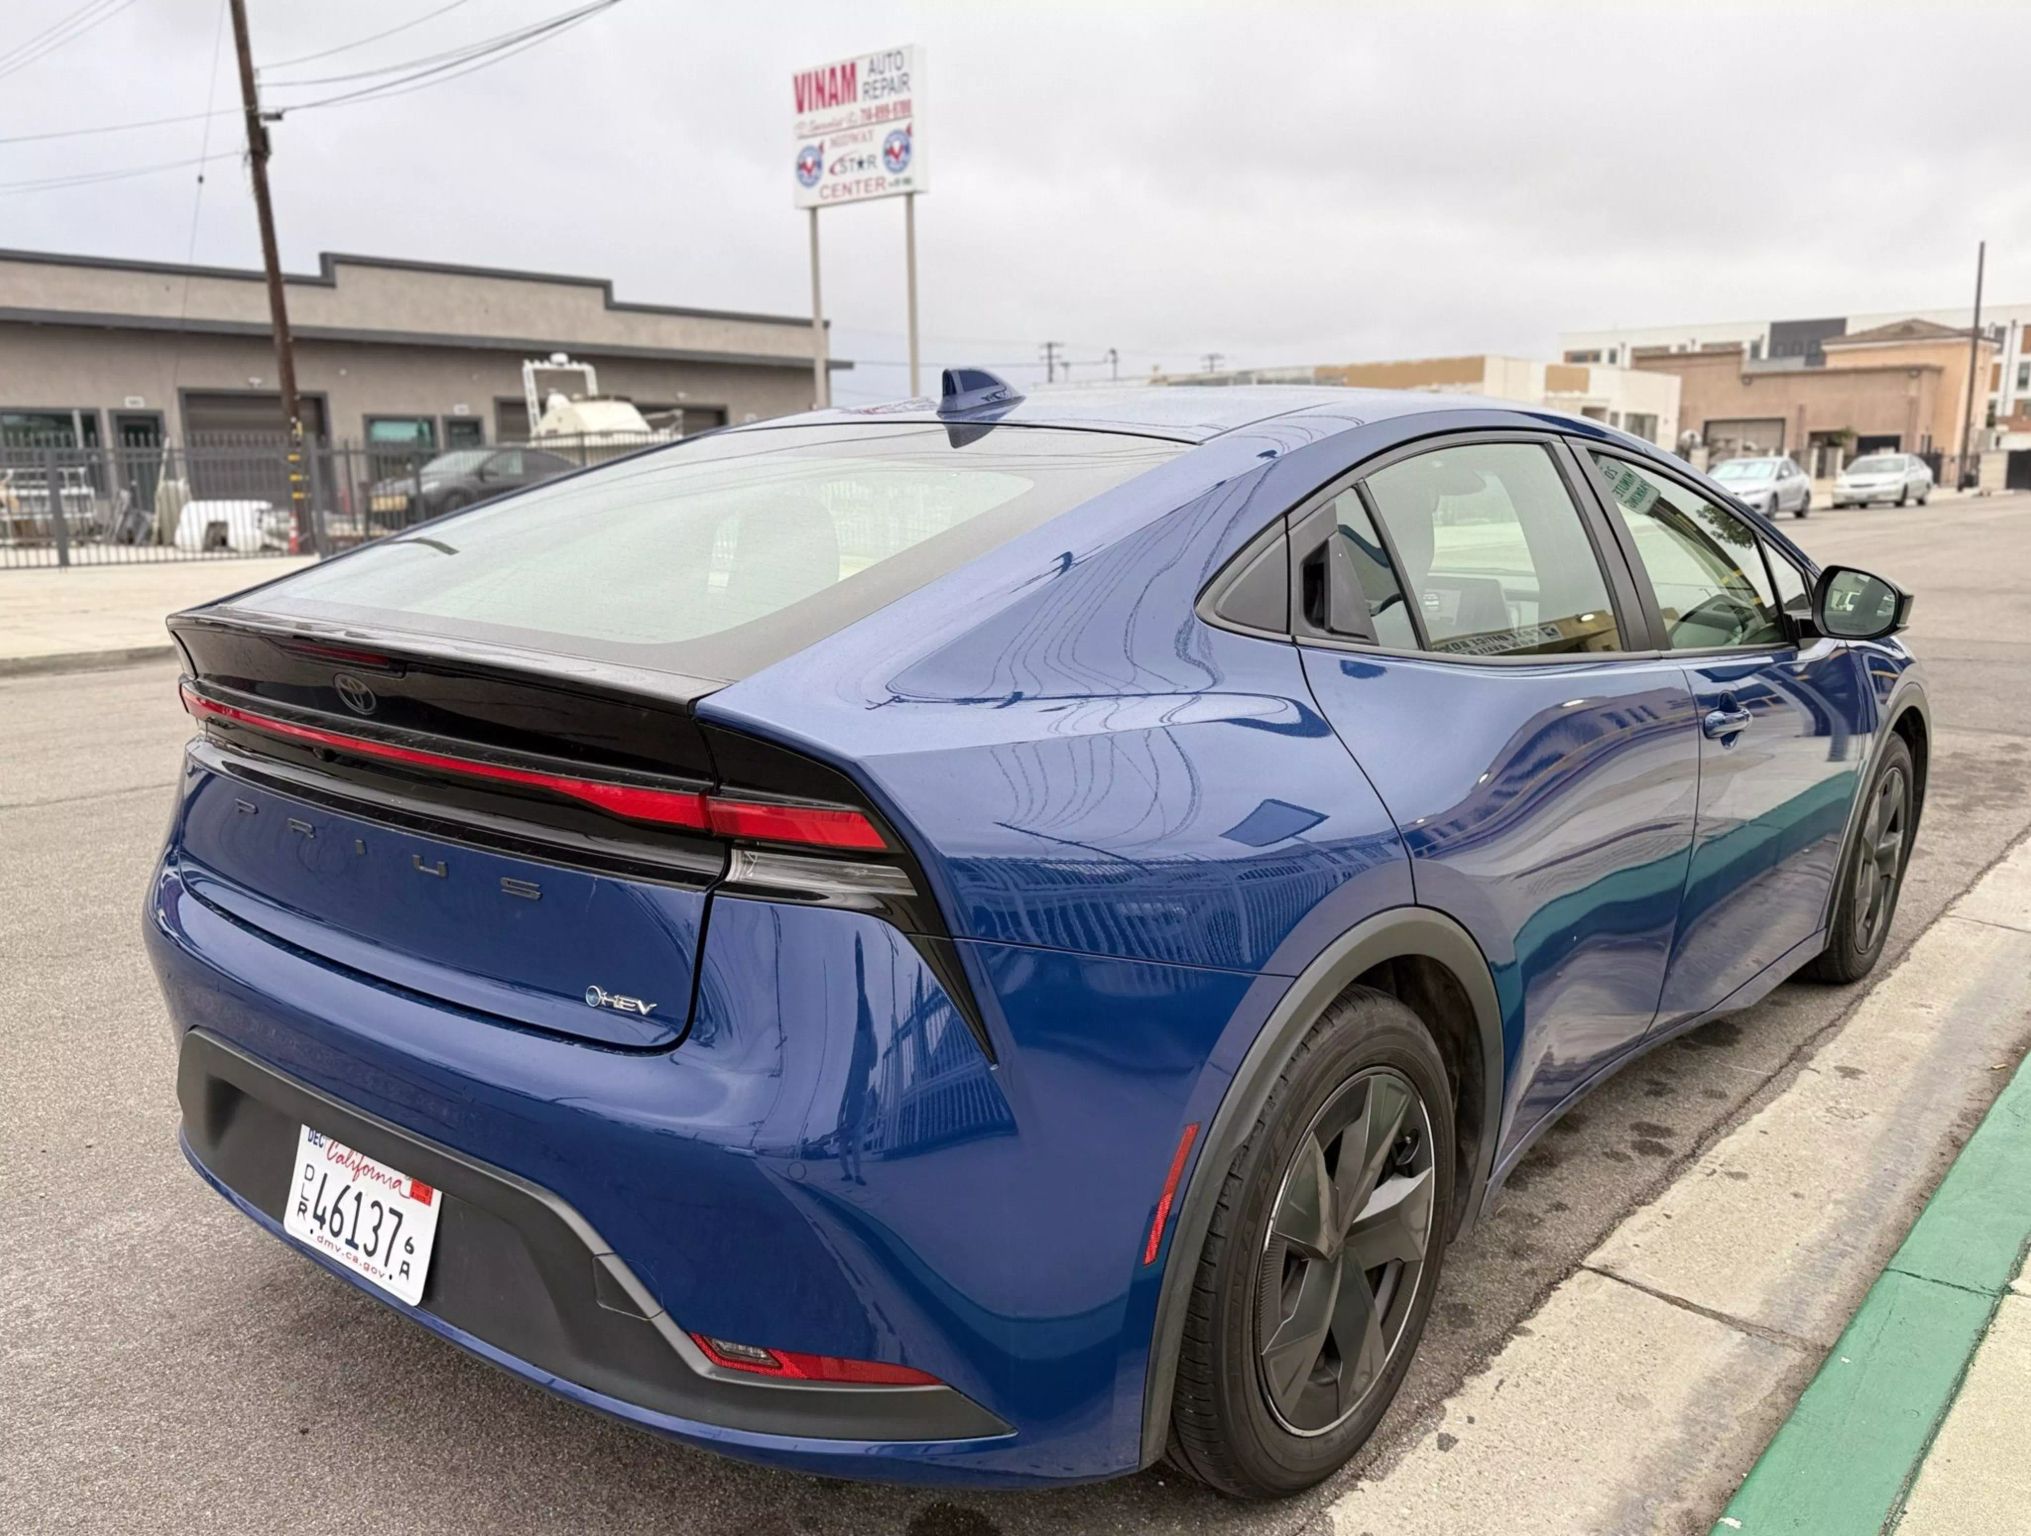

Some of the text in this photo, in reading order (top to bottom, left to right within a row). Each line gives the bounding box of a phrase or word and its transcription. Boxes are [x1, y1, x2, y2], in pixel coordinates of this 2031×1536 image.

[794, 61, 857, 114] VINAM
[863, 73, 911, 101] REPAIR
[868, 51, 905, 78] AUTO
[819, 176, 886, 200] CENTER
[234, 798, 544, 901] PRIUS
[307, 1127, 325, 1149] DEC
[326, 1140, 411, 1200] California
[312, 1172, 404, 1268] 46137
[316, 1233, 386, 1279] dmv.ca.gov
